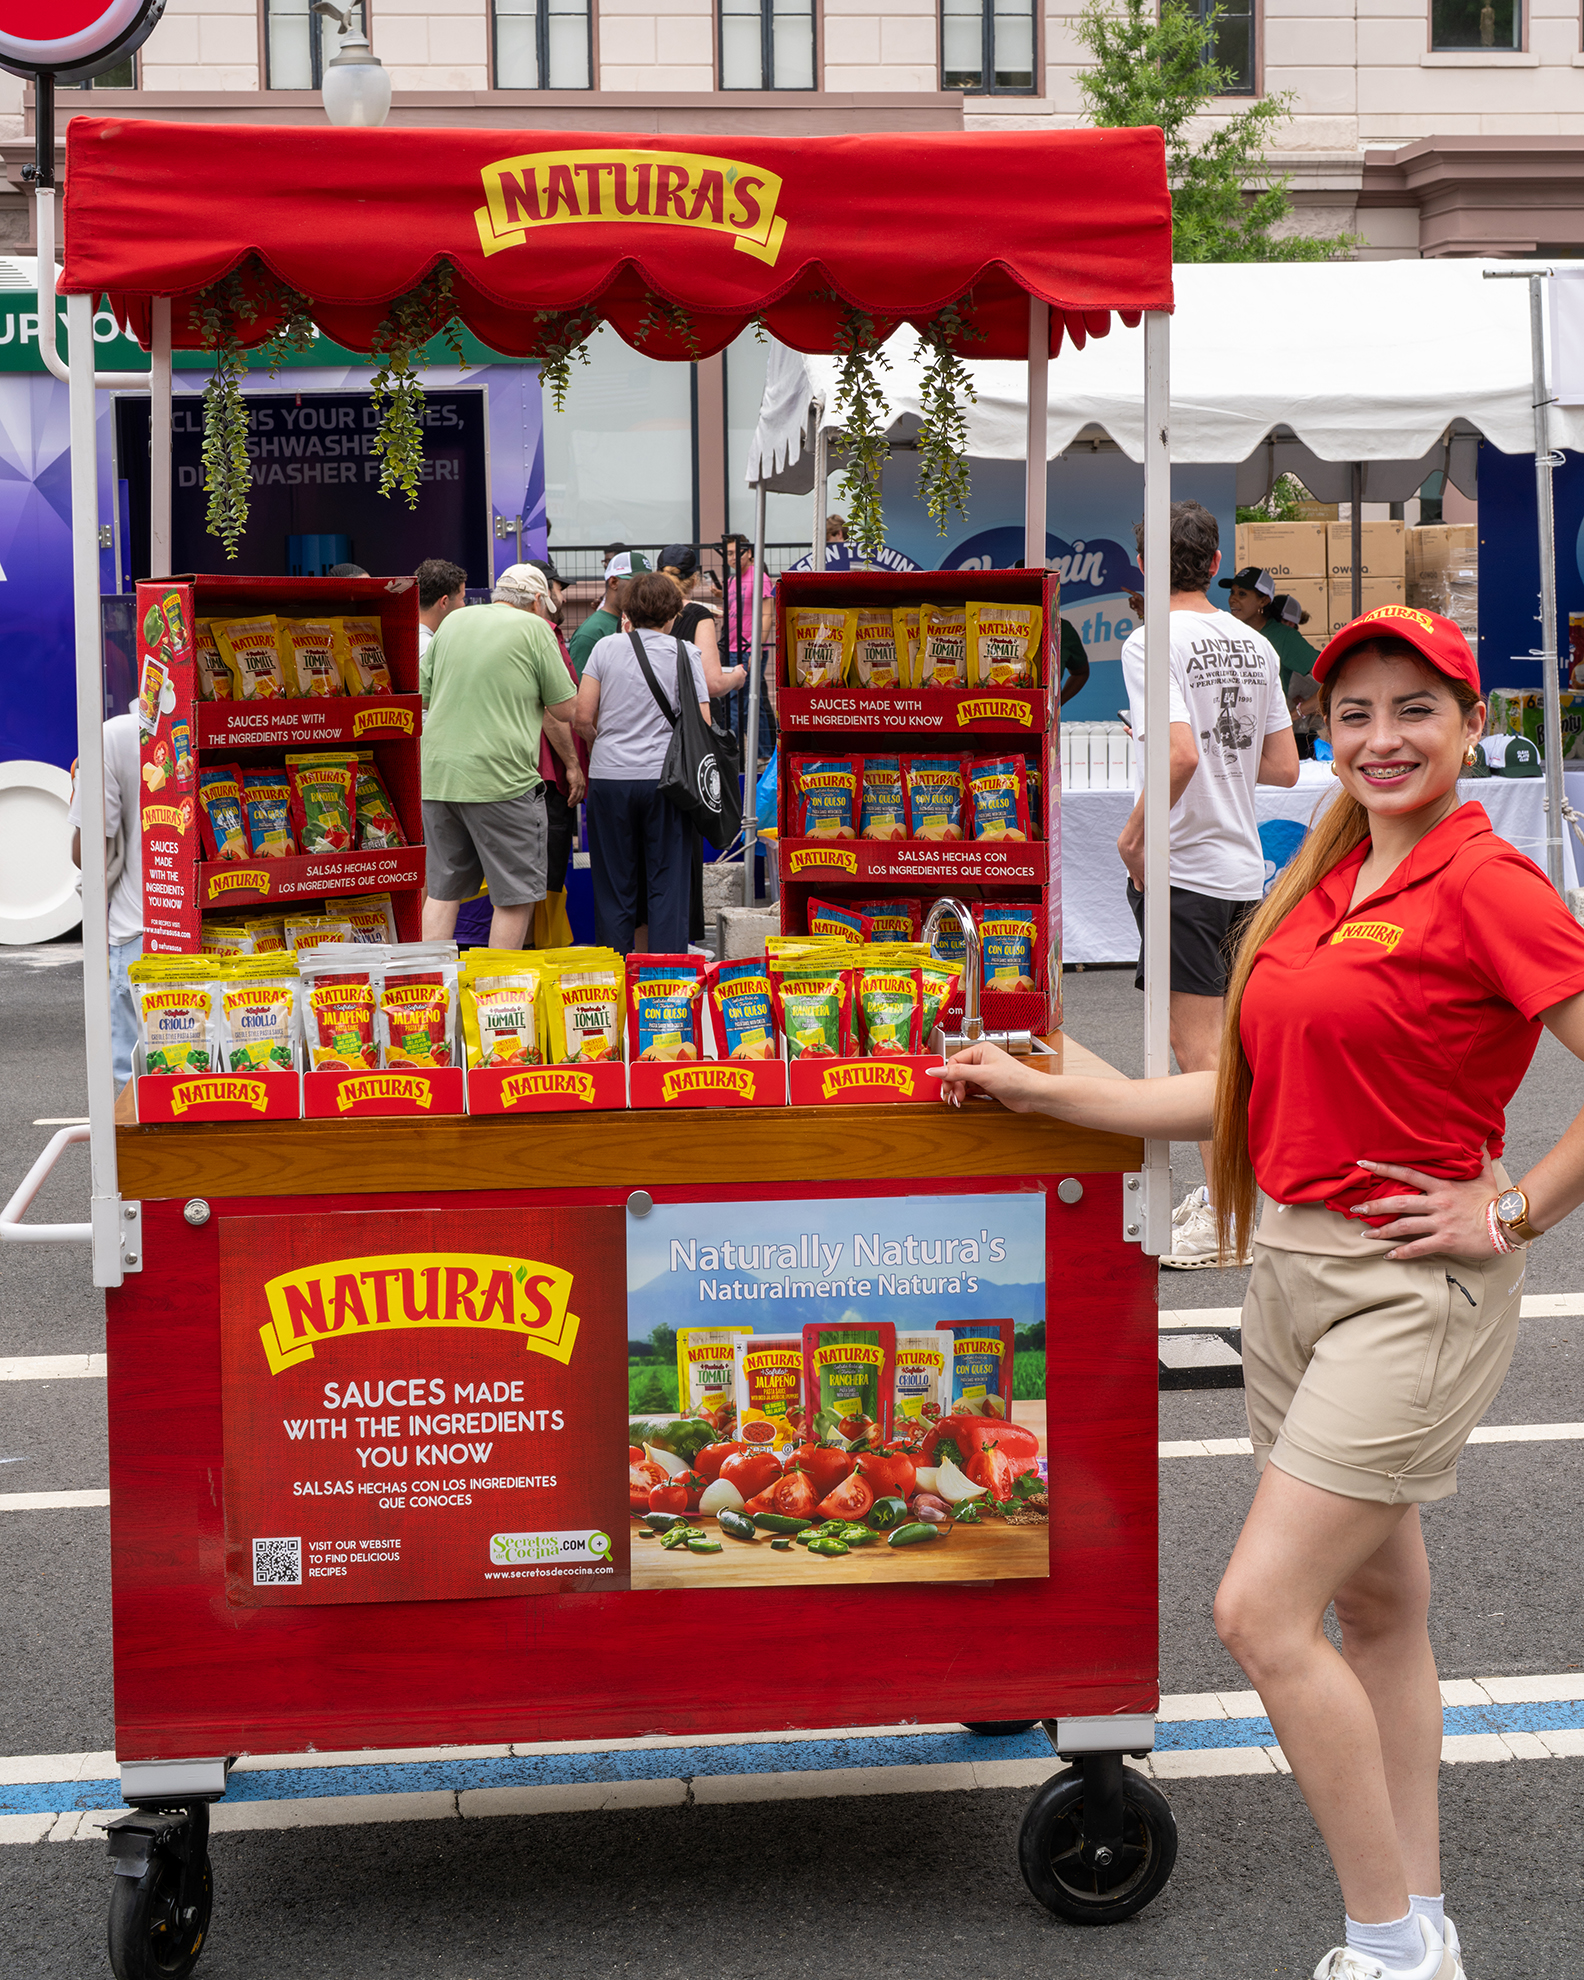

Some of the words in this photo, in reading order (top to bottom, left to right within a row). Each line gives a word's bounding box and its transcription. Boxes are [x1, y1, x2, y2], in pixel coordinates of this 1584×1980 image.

[497, 163, 765, 229] NATURA'S
[280, 406, 357, 431] YOUR
[877, 548, 914, 571] WIN
[979, 623, 1029, 636] NATURA'S
[1081, 612, 1133, 645] the
[231, 635, 276, 652] NATURA'S
[932, 644, 965, 658] TOMATE
[1191, 639, 1256, 655] UNDER
[244, 655, 274, 670] TOMATE
[1186, 654, 1266, 673] ARMOUR
[810, 699, 856, 710] SAUCES
[860, 700, 891, 711] MADE
[893, 700, 922, 711] WITH
[961, 701, 1027, 719] NATURA'S
[1527, 695, 1535, 709] 6
[228, 714, 269, 728] SAUCES
[272, 714, 299, 726] MADE
[302, 713, 326, 725] WITH
[358, 711, 411, 728] NATURA'S
[790, 715, 809, 725] THE
[812, 715, 880, 725] INGREDIENTS
[883, 716, 906, 726] YOU
[909, 716, 943, 726] KNOW
[208, 734, 226, 745] THE
[228, 731, 288, 744] INGREDIENTS
[291, 730, 310, 741] YOU
[312, 728, 342, 739] KNOW
[801, 775, 852, 789] NATURA'S
[824, 797, 846, 807] QUESO
[864, 795, 876, 803] CON
[879, 795, 900, 804] QUESO
[932, 795, 954, 804] QUESO
[989, 798, 1009, 809] QUESO
[145, 808, 182, 826] NATURA'S
[150, 840, 178, 854] SAUCES
[154, 856, 173, 867] MADE
[794, 852, 852, 868] NATURA'S
[897, 851, 940, 862] SALSAS
[942, 852, 982, 862] HECHAS
[984, 852, 1007, 862] CON
[149, 869, 165, 880] WITH
[167, 871, 178, 882] THE
[306, 864, 342, 877] SALSAS
[344, 862, 377, 874] HECHAS
[379, 860, 397, 871] CON
[868, 865, 887, 875] LOS
[889, 866, 958, 876] INGREDIENTES
[960, 866, 982, 877] QUE
[984, 867, 1035, 877] CONOCES
[146, 882, 184, 896] INGREDIENTS
[213, 872, 267, 890] NATURA'S
[279, 882, 296, 894] LOS
[297, 877, 356, 892] INGREDIENTES
[358, 875, 376, 886] QUE
[377, 872, 418, 885] CONOCES
[148, 896, 161, 907] YOU
[163, 898, 182, 909] KNOW
[814, 921, 860, 944] NATURA'S
[983, 924, 1032, 936] NATURA'S
[988, 945, 1002, 955] CON
[1004, 945, 1025, 955] QUESO
[638, 984, 697, 998] NATURA'S
[718, 981, 769, 999] NATURA'S
[783, 982, 839, 996] NATURA'S
[862, 980, 912, 993] NATURA'S
[146, 993, 207, 1009] NATURA'S
[227, 990, 288, 1008] NATURA'S
[314, 988, 373, 1005] NATURA'S
[384, 988, 444, 1005] NATURA'S
[562, 988, 618, 1006] NATURA'S
[322, 1008, 370, 1026] JALAPEÑO
[392, 1008, 440, 1026] JALAPEÑO
[486, 1011, 525, 1028] TOMATE
[574, 1011, 610, 1027] TOMATE
[645, 1008, 661, 1019] CON
[663, 1008, 687, 1019] QUESO
[729, 1008, 742, 1019] CON
[744, 1004, 768, 1017] QUESO
[159, 1017, 195, 1031] CRIOLLO
[241, 1014, 277, 1028] CRIOLLO
[508, 1074, 588, 1095] NATURA'S
[669, 1069, 749, 1091] NATURA'S
[828, 1066, 909, 1089] NATURA'S
[178, 1082, 261, 1105] NATURA'S
[343, 1078, 425, 1099] NATURA'S
[669, 1234, 844, 1277] Naturally
[853, 1229, 1007, 1267] Natura's
[699, 1276, 871, 1301] Naturalmente
[878, 1271, 979, 1296] Natura's
[282, 1265, 556, 1340] NATURA'S
[747, 1354, 802, 1369] NATURA'S
[819, 1347, 879, 1364] NATURA'S
[697, 1369, 732, 1383] TOMATE
[956, 1366, 970, 1374] CON
[972, 1364, 993, 1374] QUESO
[755, 1373, 796, 1388] JALAPEÑO
[829, 1374, 869, 1386] RANCHERA
[899, 1374, 929, 1386] CRIOLLO
[323, 1378, 445, 1410] SAUCES
[454, 1380, 524, 1405] MADE
[283, 1418, 347, 1441] WITH
[355, 1415, 401, 1438] THE
[409, 1409, 565, 1437] INGREDIENTS
[356, 1446, 408, 1468] YOU
[415, 1442, 493, 1466] KNOW
[293, 1480, 354, 1496] SALSAS
[358, 1480, 408, 1495] HECHAS
[411, 1479, 440, 1493] CON
[443, 1479, 467, 1492] LOS
[470, 1475, 557, 1491] INGREDIENTES
[379, 1497, 405, 1510] QUE
[409, 1494, 472, 1508] CONOCES
[309, 1541, 332, 1551] VISIT
[335, 1540, 357, 1550] OUR
[359, 1538, 402, 1549] WEBSITE
[494, 1536, 558, 1553] Secretos
[505, 1546, 559, 1562] Cocina
[560, 1540, 585, 1551] .COM
[309, 1554, 323, 1564] TO
[326, 1553, 347, 1563] FIND
[349, 1551, 400, 1562] DELICIOUS
[309, 1567, 347, 1577] RECIPES
[484, 1566, 614, 1579] www.secretosdecocina.com
